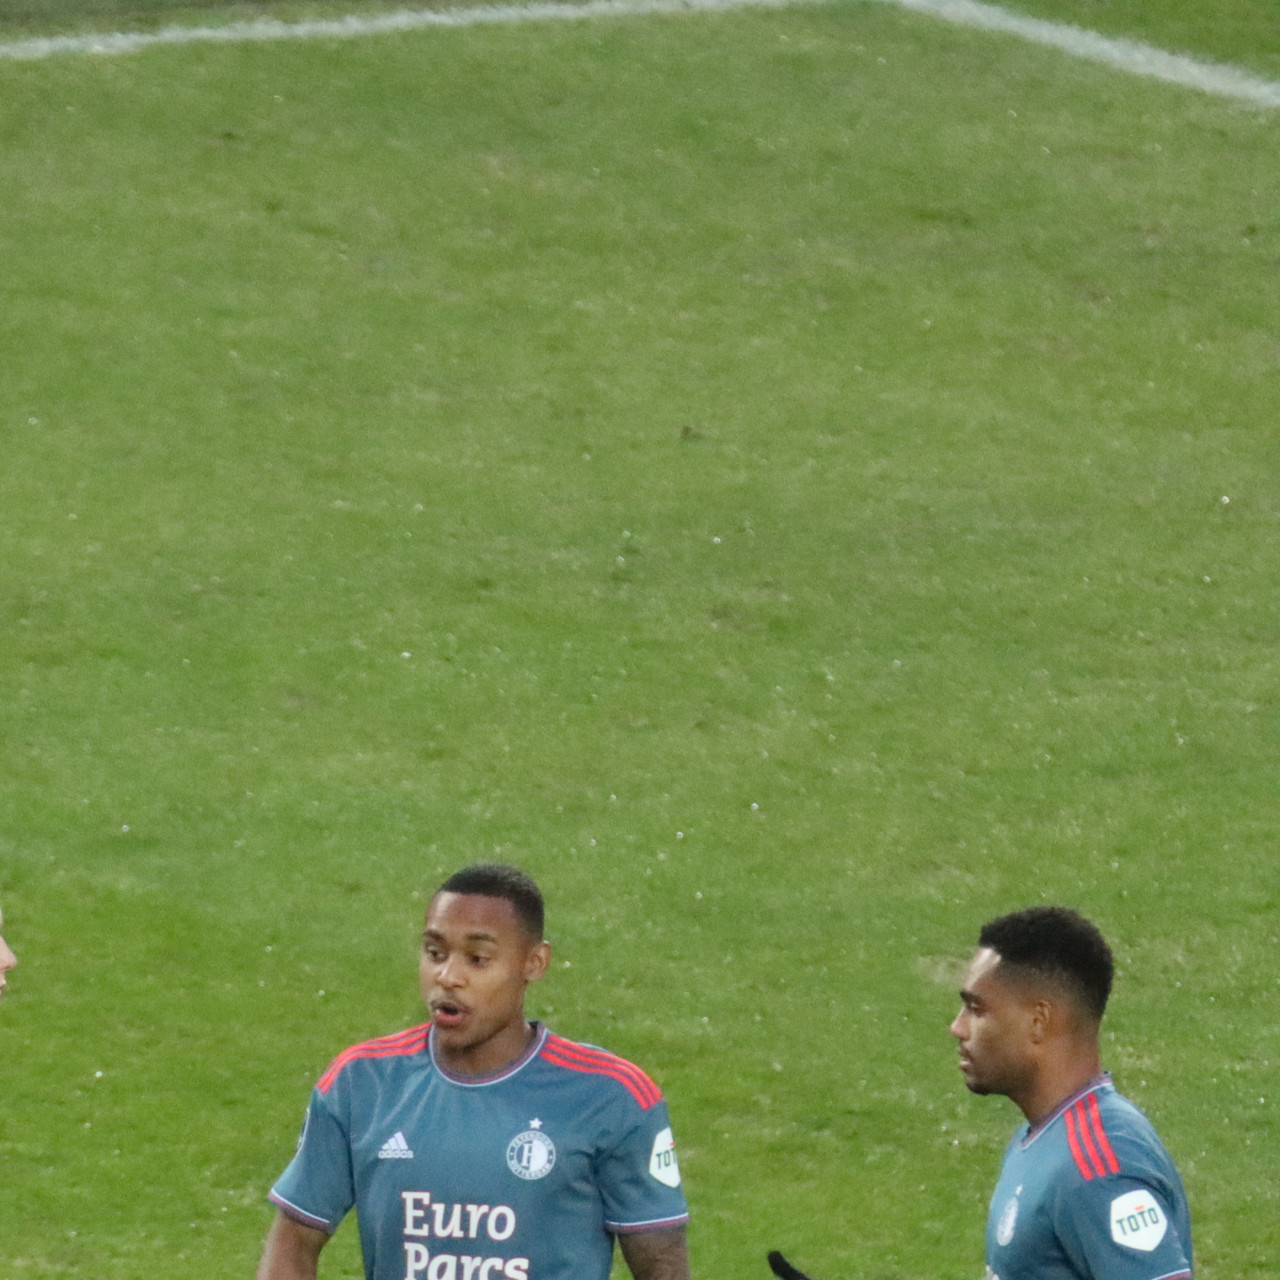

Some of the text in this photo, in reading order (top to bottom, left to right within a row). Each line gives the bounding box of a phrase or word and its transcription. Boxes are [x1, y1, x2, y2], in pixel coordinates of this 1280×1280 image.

[655, 1147, 677, 1170] TOT
[401, 1191, 516, 1241] Euro
[1116, 1208, 1159, 1236] TOTO
